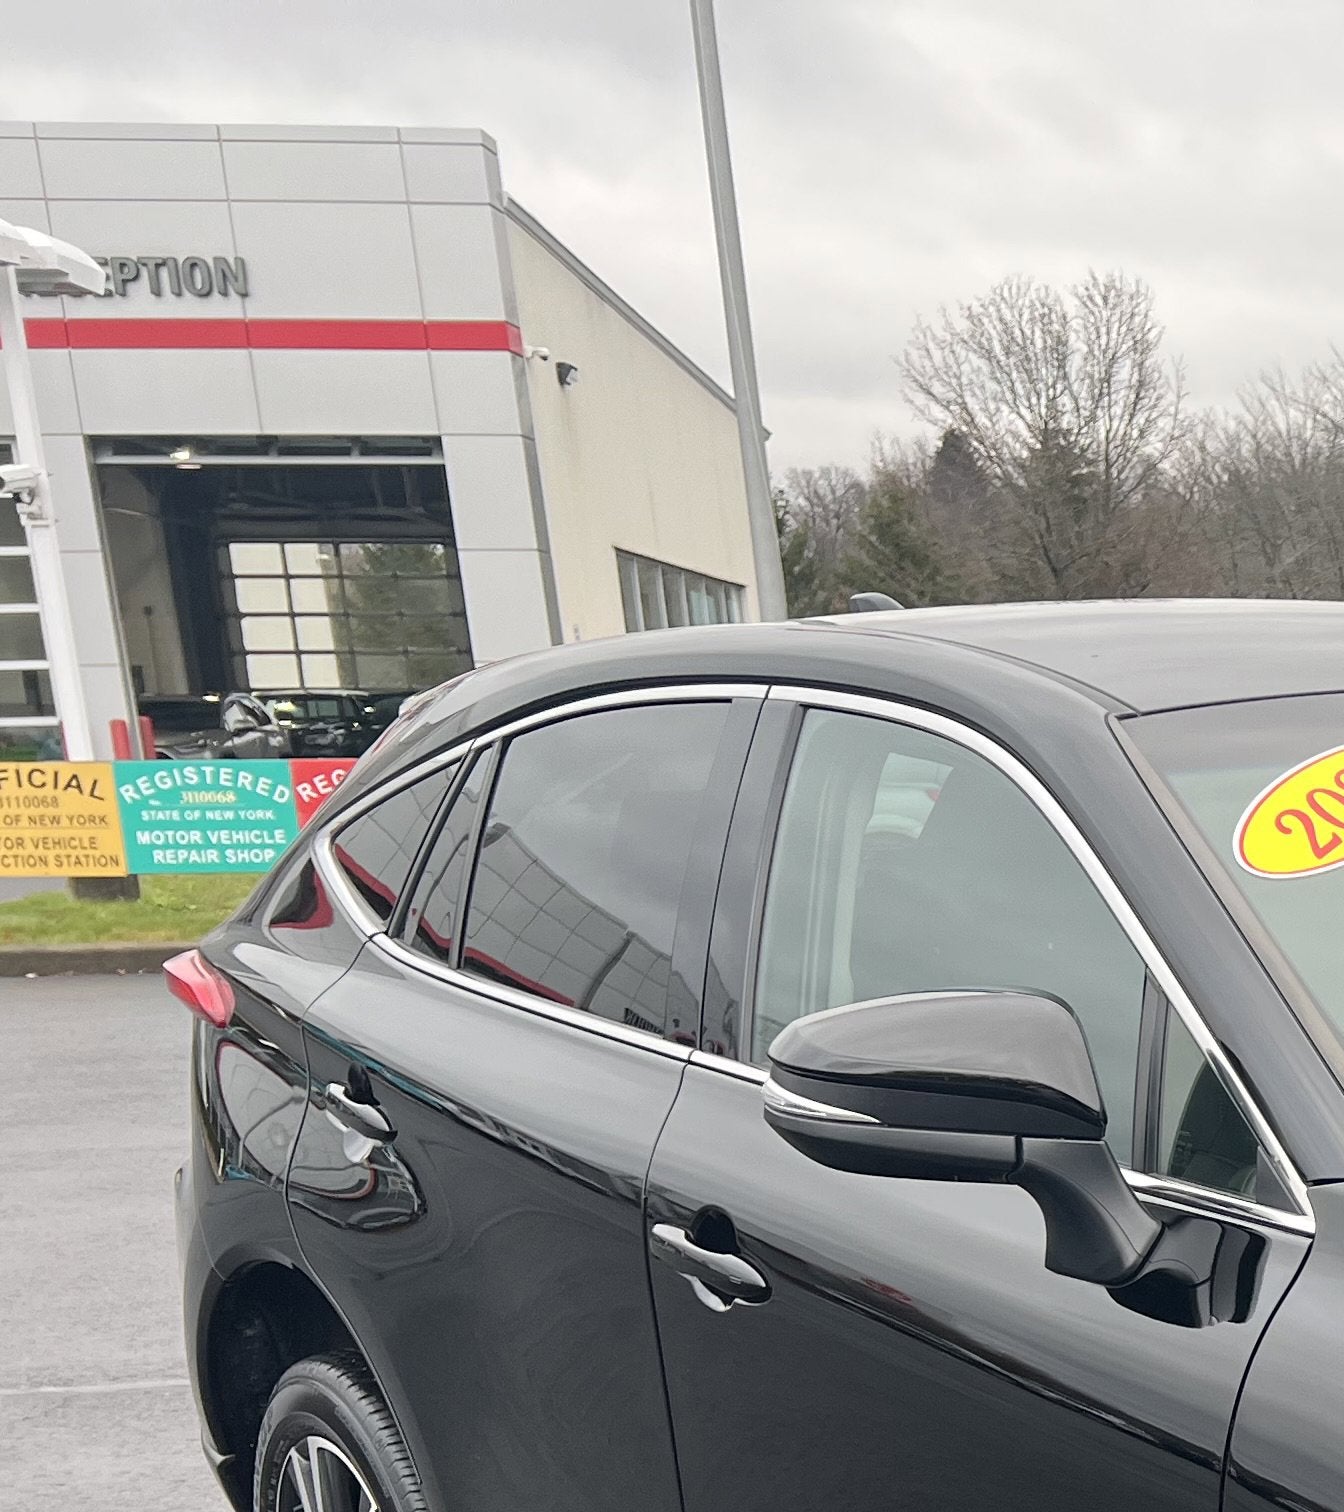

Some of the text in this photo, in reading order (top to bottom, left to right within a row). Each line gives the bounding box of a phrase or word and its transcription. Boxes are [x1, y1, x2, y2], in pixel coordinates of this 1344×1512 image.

[19, 256, 249, 297] PTION
[119, 766, 290, 804] REGISTERED
[3, 814, 109, 826] OF NEW YORK
[141, 810, 275, 821] STATE OF NEW YORK
[31, 836, 98, 850] VEHICLE
[136, 829, 287, 845] MOTOR VEHICLE
[54, 854, 120, 868] STATION
[152, 849, 276, 865] REPAIR SHOP
